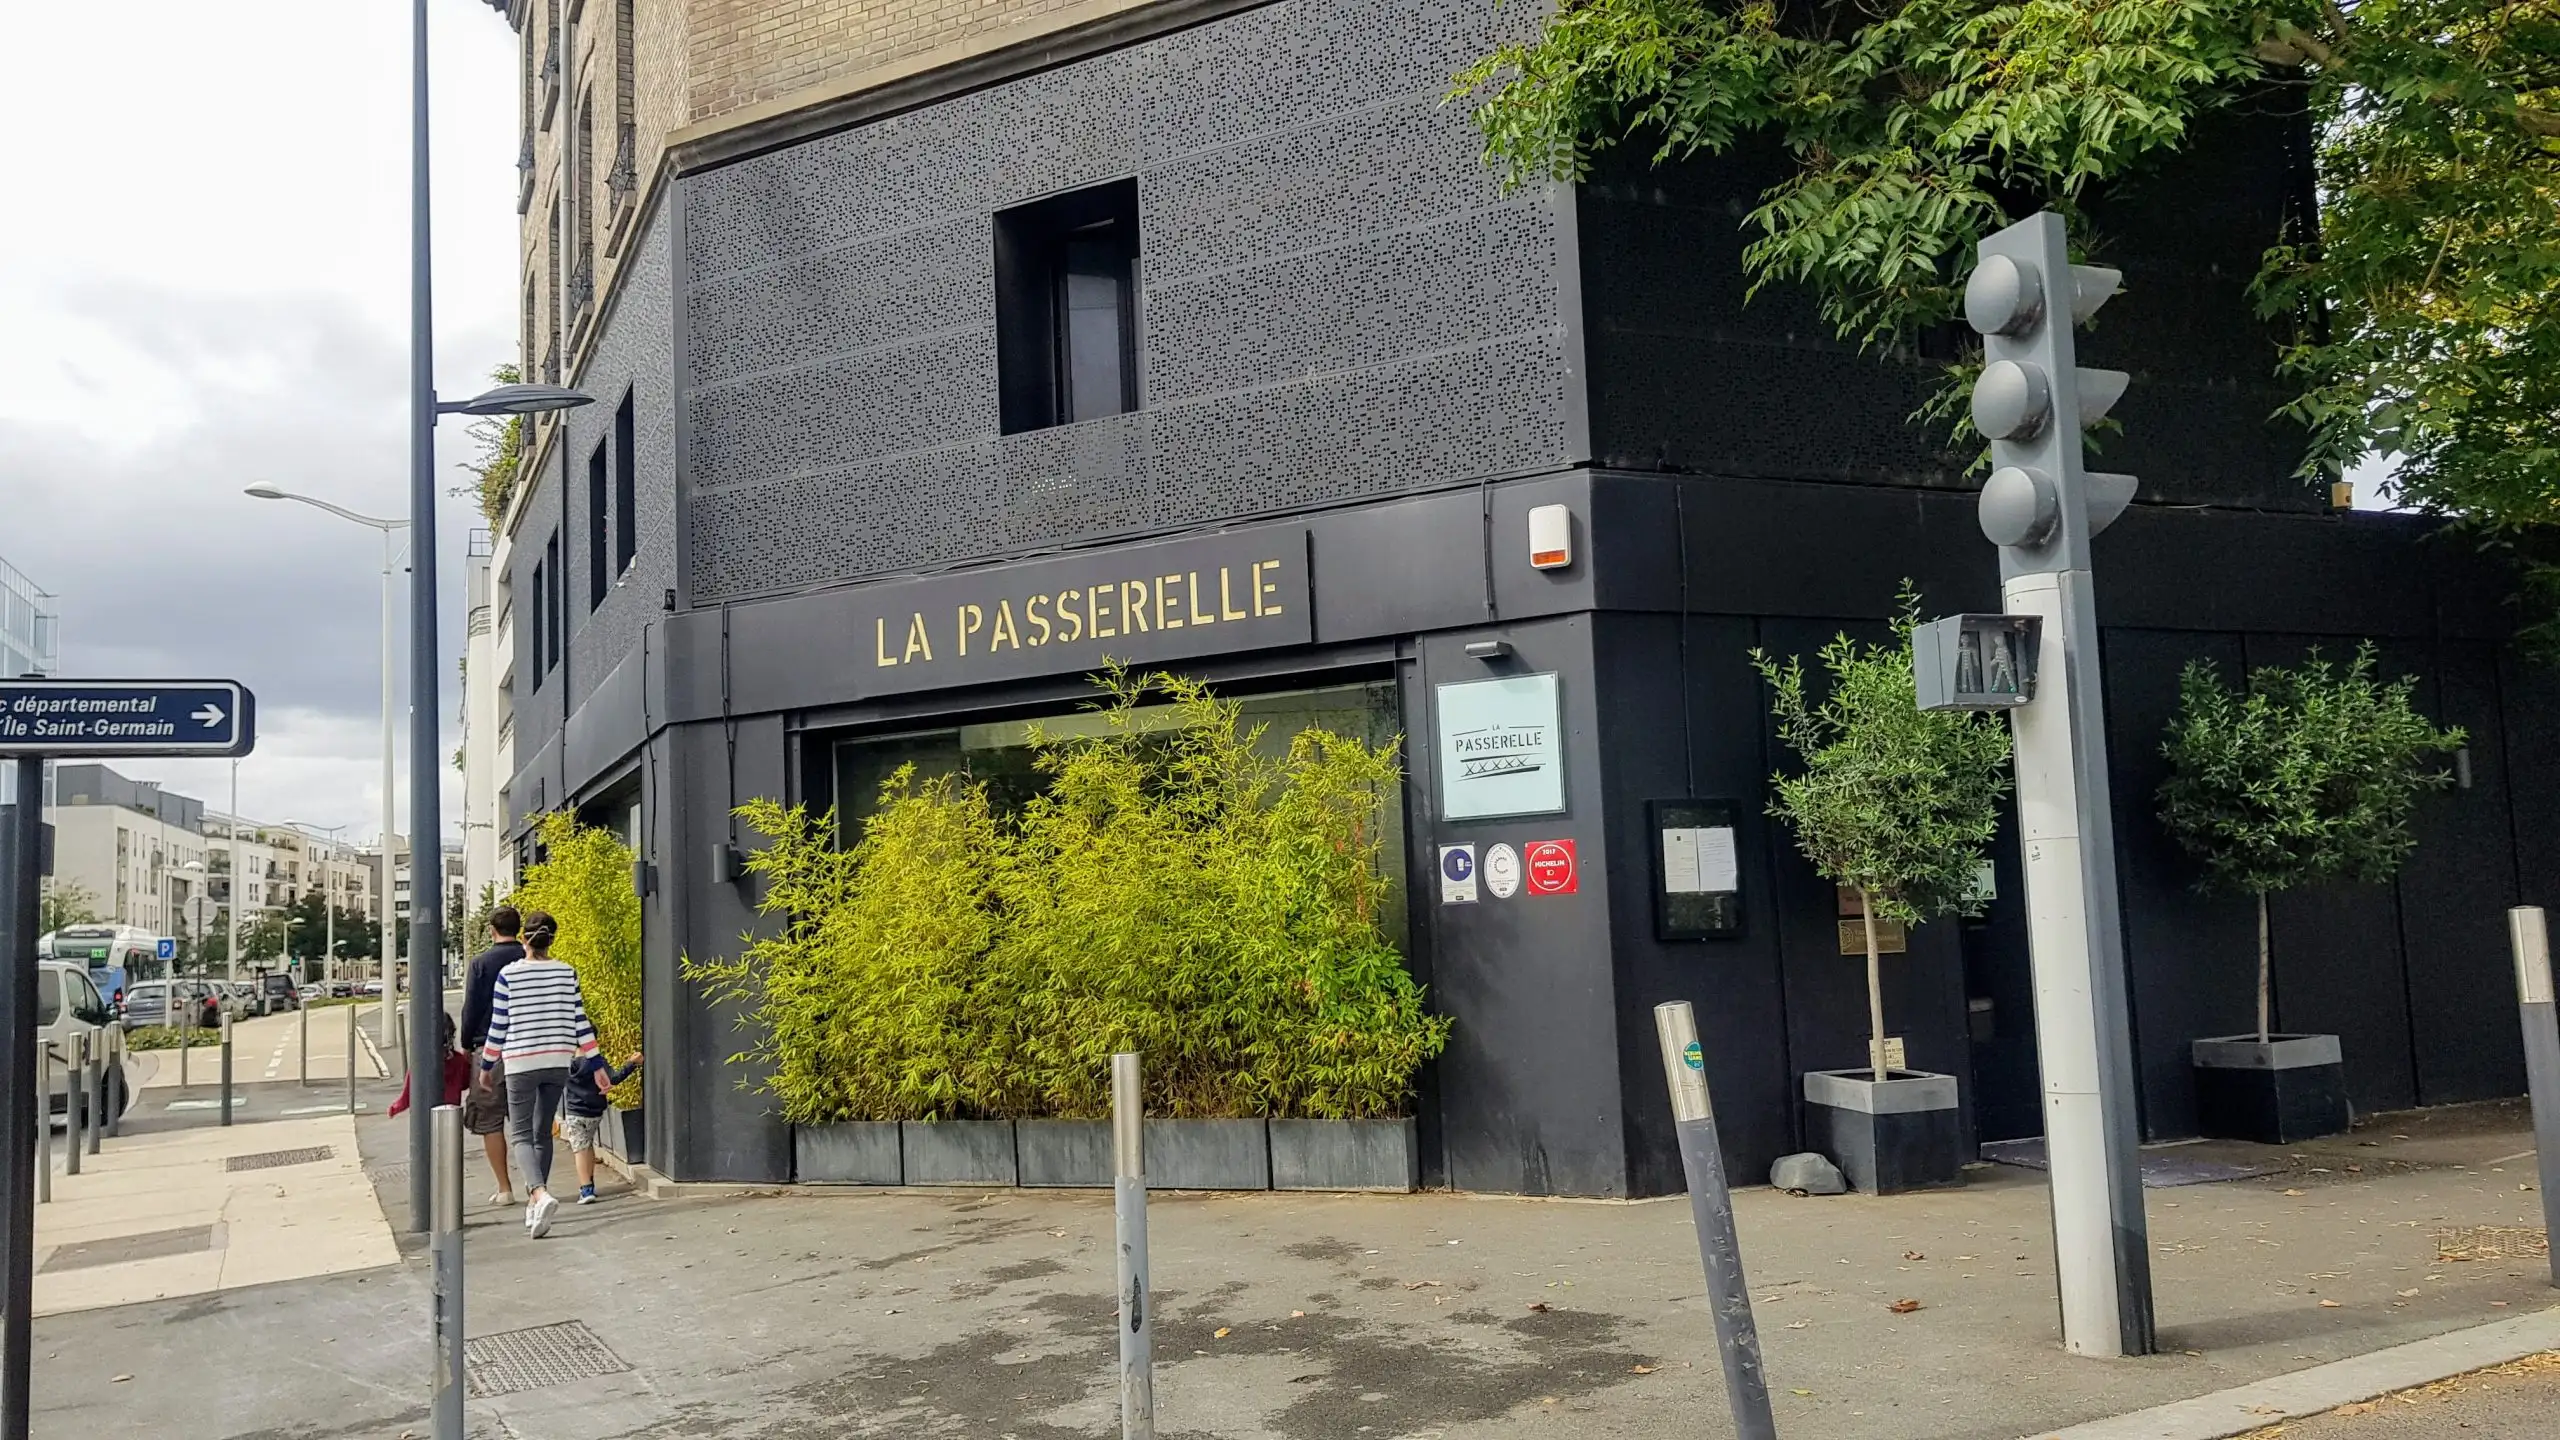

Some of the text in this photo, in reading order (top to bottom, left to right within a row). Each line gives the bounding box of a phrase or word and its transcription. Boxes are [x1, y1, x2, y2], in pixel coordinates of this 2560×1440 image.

[876, 559, 1284, 667] LA PASSERELLE
[14, 695, 157, 716] départemental
[33, 718, 175, 736] Saint-Germain
[1456, 731, 1543, 753] PASSERELLE
[1534, 860, 1566, 868] MICHELIN
[161, 942, 170, 956] P
